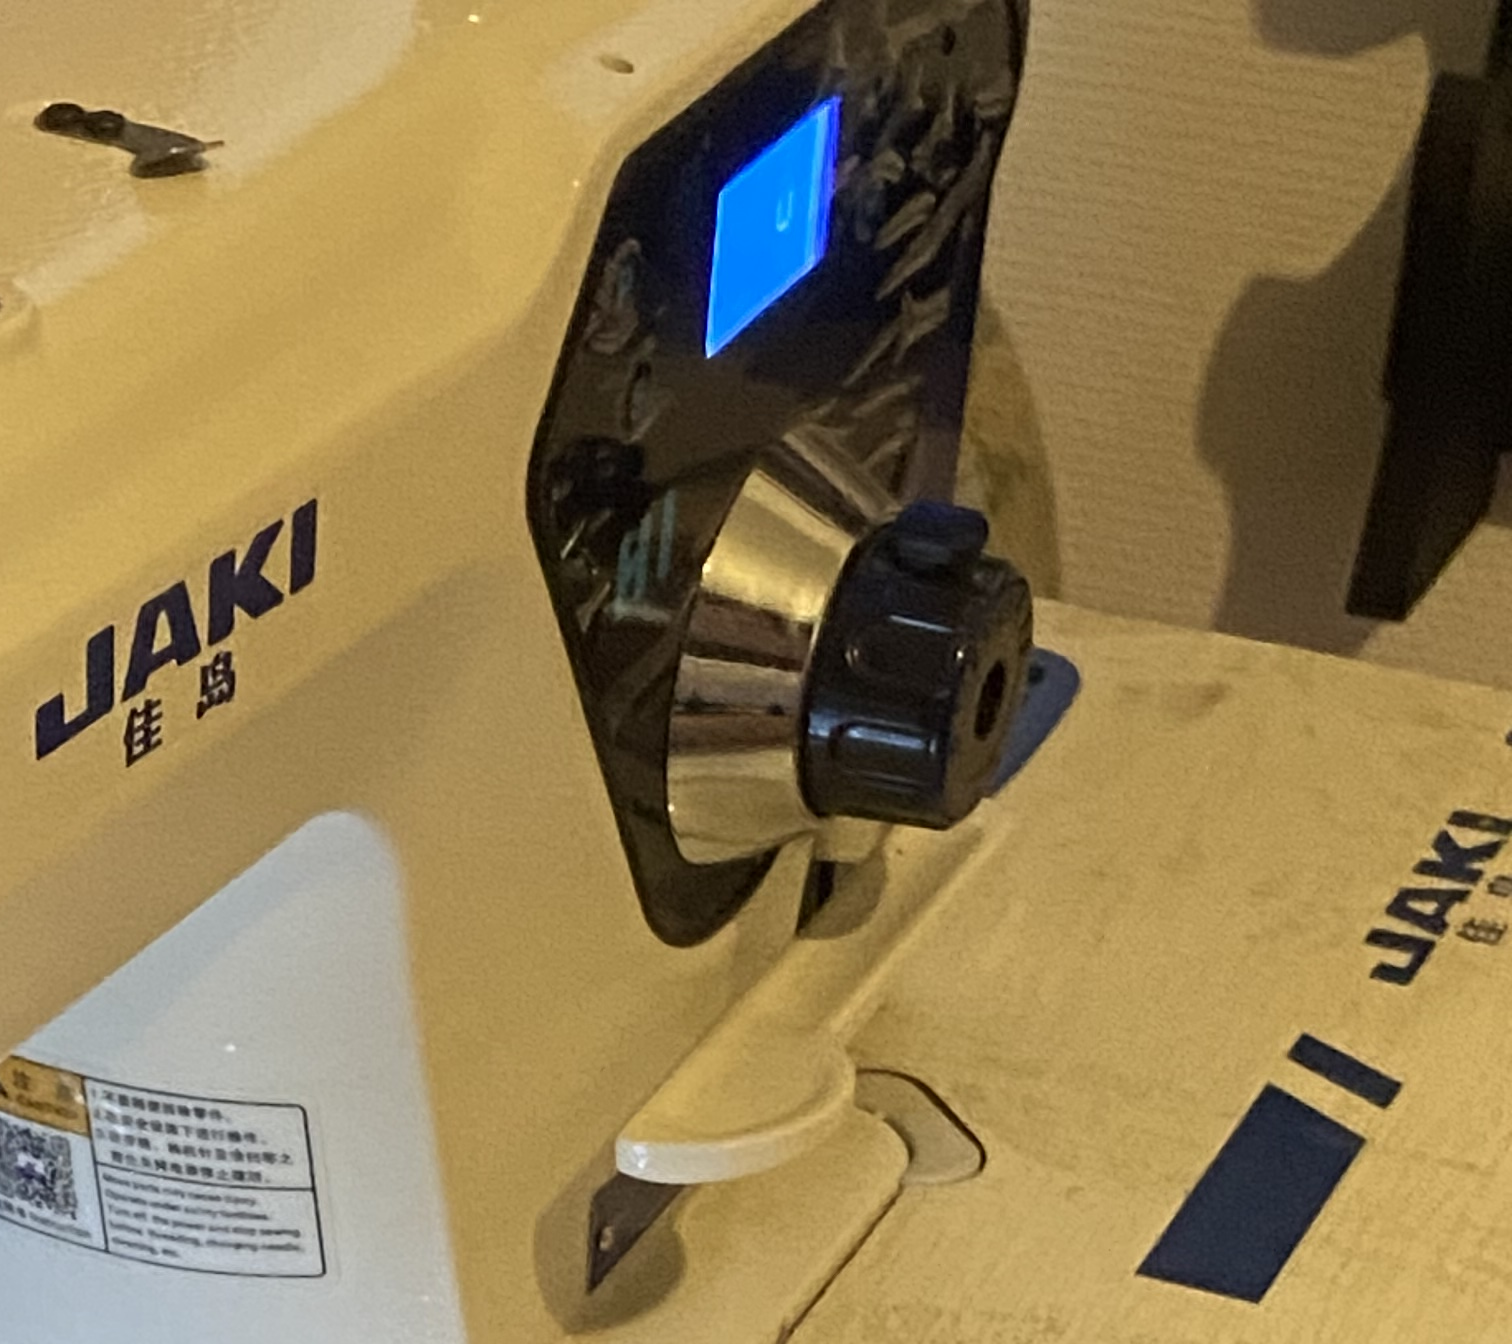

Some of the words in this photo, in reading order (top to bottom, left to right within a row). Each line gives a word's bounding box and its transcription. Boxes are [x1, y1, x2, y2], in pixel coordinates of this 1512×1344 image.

[36, 498, 318, 761] JAKI
[124, 650, 237, 768] 佳岛
[1364, 809, 1512, 986] JAKI
